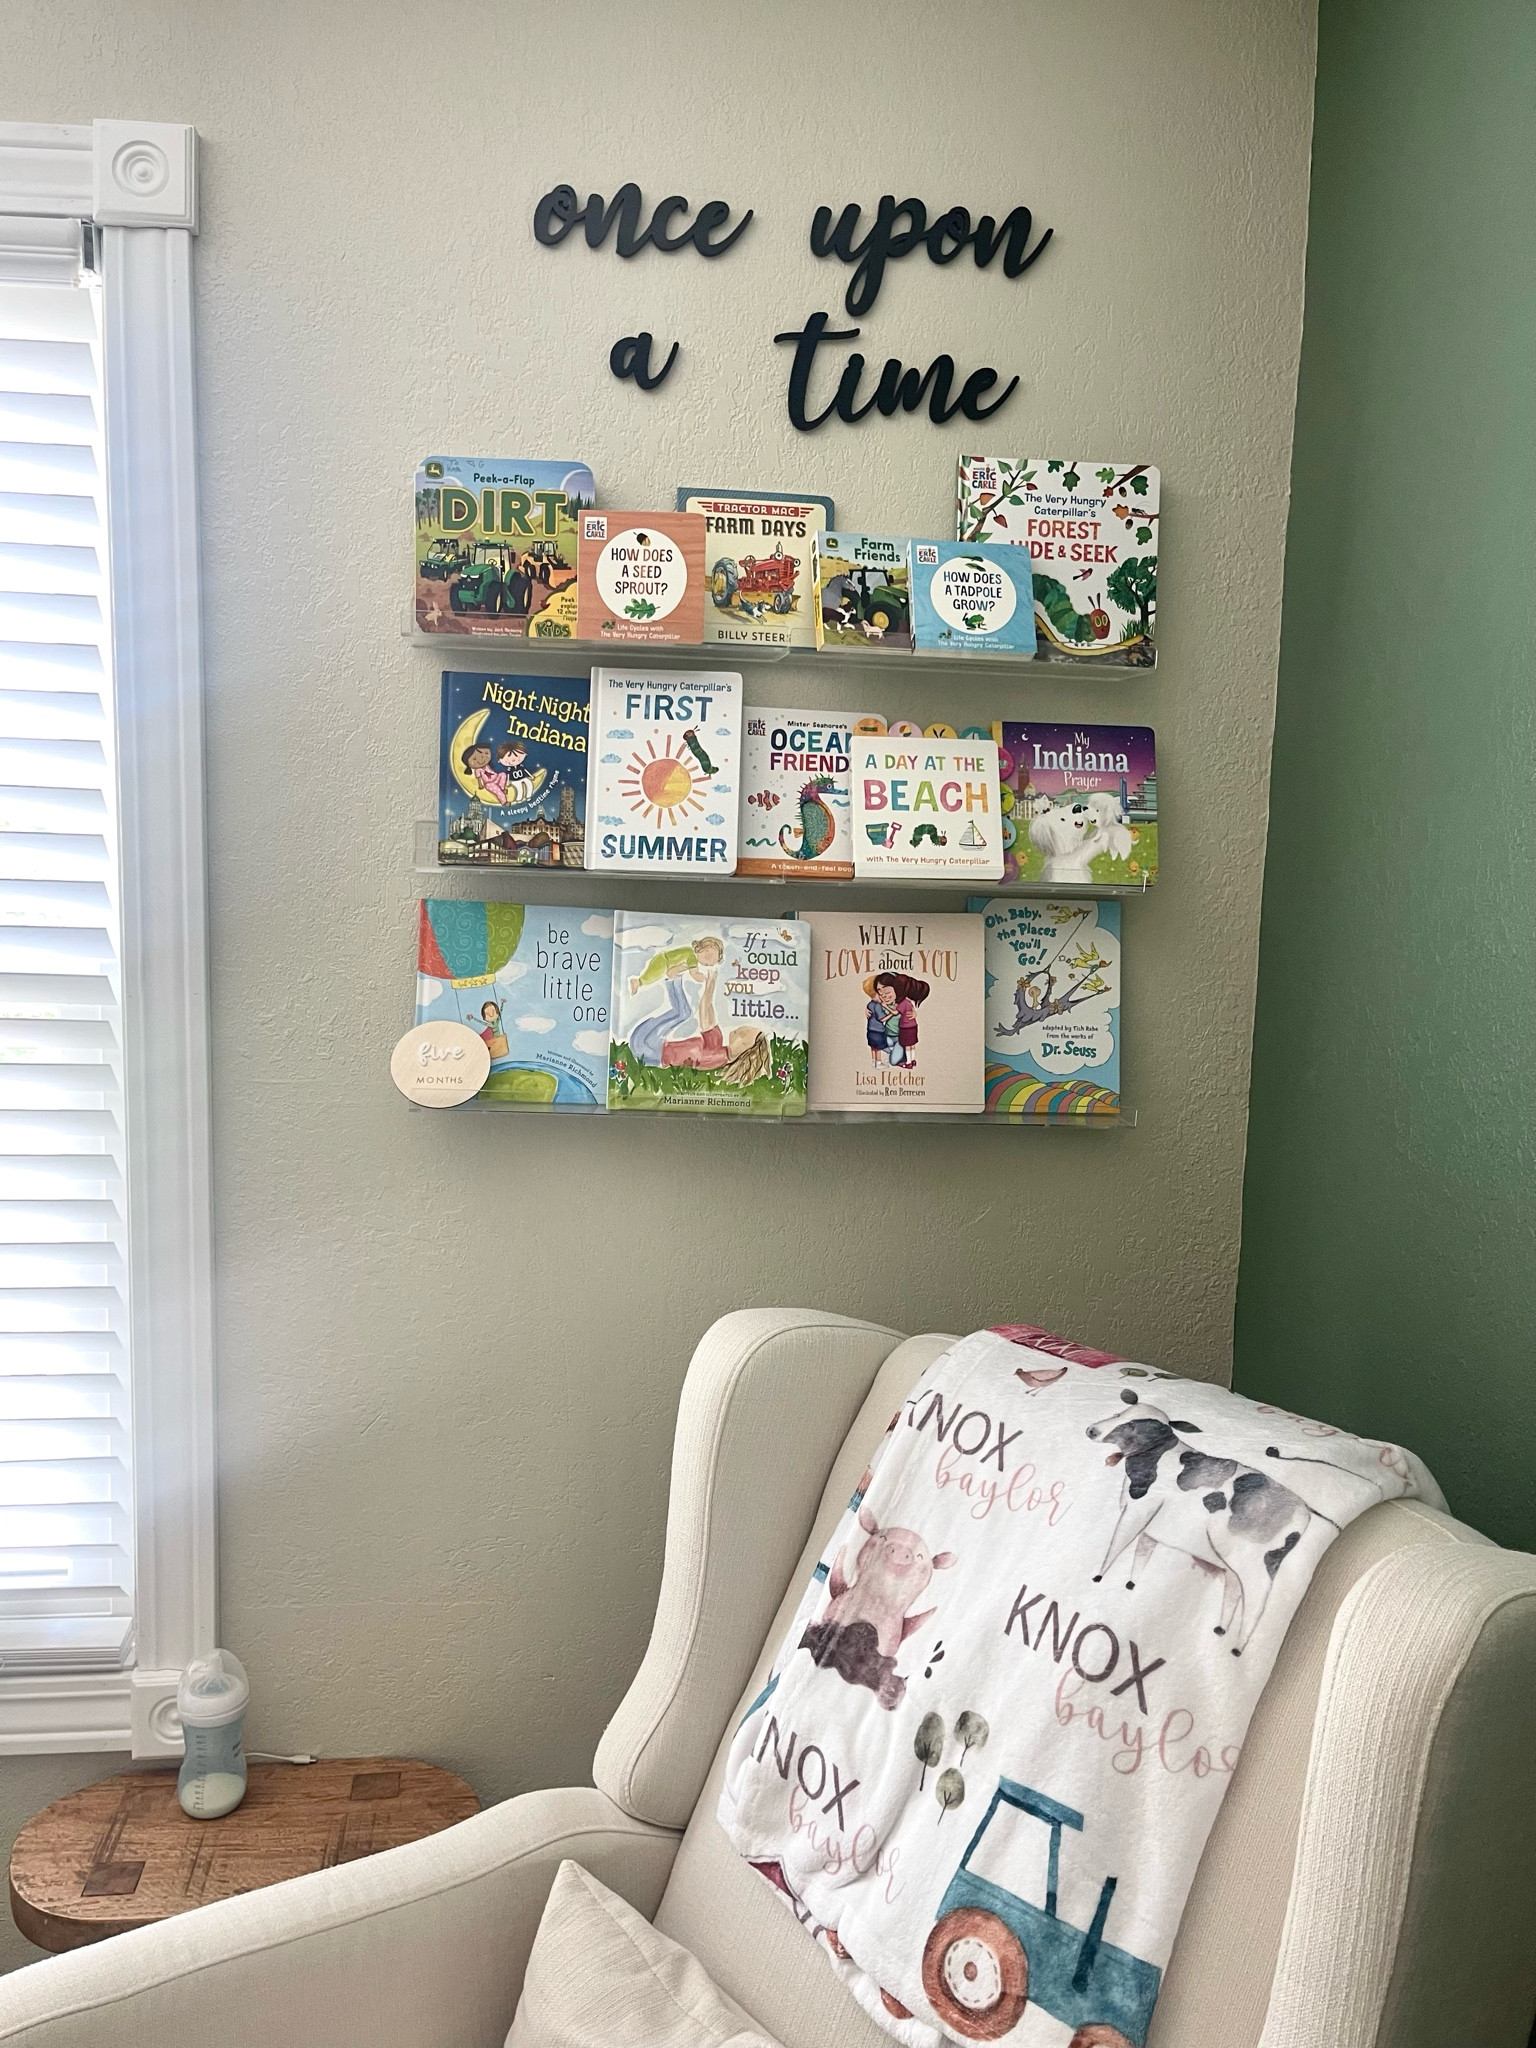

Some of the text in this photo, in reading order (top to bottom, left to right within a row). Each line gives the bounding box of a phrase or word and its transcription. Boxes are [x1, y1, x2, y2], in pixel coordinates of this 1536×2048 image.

[533, 183, 1054, 316] once upon
[609, 312, 1020, 431] a time
[473, 473, 535, 488] Peek-a-Flap
[972, 467, 996, 480] ERIC
[972, 480, 997, 489] CARLE
[1025, 492, 1107, 508] The Very Hungry
[440, 486, 568, 537] DIRT
[716, 503, 796, 516] TRACTOR MAC
[1034, 506, 1096, 518] Caterpillar's
[586, 521, 605, 531] ERIC
[586, 530, 605, 538] CARLE
[706, 516, 806, 538] FARM DAYS
[1027, 519, 1101, 540] FOREST
[861, 538, 894, 551] Farm
[1058, 545, 1066, 558] &
[1070, 543, 1118, 563] SEEK
[611, 548, 673, 562] HOW DOES
[854, 548, 900, 562] Friends
[622, 565, 662, 579] A SEED
[943, 571, 1002, 585] HOW DOES
[615, 581, 668, 595] SPROUT?
[945, 585, 1002, 598] A TADPOLE
[953, 599, 995, 611] GROW?
[627, 632, 648, 640] Hungry
[630, 624, 649, 632] Cycles
[718, 630, 748, 640] BILLY
[609, 679, 732, 693] The Very Hungry Caterpillar's
[482, 681, 590, 724] Night-Night
[625, 694, 713, 722] FIRST
[747, 719, 766, 729] ERIC
[787, 720, 848, 730] Mister Seahorse's
[507, 715, 586, 752] Indiana
[1074, 732, 1090, 749] My
[865, 754, 985, 772] A DAY AT THE
[1033, 743, 1129, 773] Indiana
[1063, 771, 1101, 789] Prayer
[507, 806, 529, 816] sleepy
[528, 788, 551, 809] bedtime
[864, 779, 988, 813] BEACH
[601, 834, 728, 863] SUMMER
[901, 856, 918, 864] Very
[920, 857, 946, 866] Hungry
[949, 857, 990, 866] Caterpillar
[548, 923, 569, 946] be
[858, 925, 924, 946] WHAT I
[997, 922, 1057, 941] the Places
[743, 932, 768, 952] If i
[1009, 938, 1041, 952] You'll
[536, 941, 601, 971] brave
[747, 951, 798, 966] could
[1018, 948, 1048, 966] Go!
[825, 949, 958, 981] LOVE about YOU
[735, 965, 780, 984] keep
[543, 973, 593, 1001] little
[724, 981, 754, 996] you
[573, 1005, 607, 1022] one
[731, 999, 799, 1020] little...
[418, 1042, 464, 1067] five
[1041, 1040, 1097, 1058] Dr. Seuss
[536, 1052, 598, 1088] Marianne Richmond
[856, 1071, 925, 1086] Lisa Fletcher
[416, 1076, 463, 1084] MONTHS
[663, 1096, 751, 1107] Marianne Richmond
[935, 1444, 1073, 1526] baylor
[1004, 1584, 1166, 1715] KNOX
